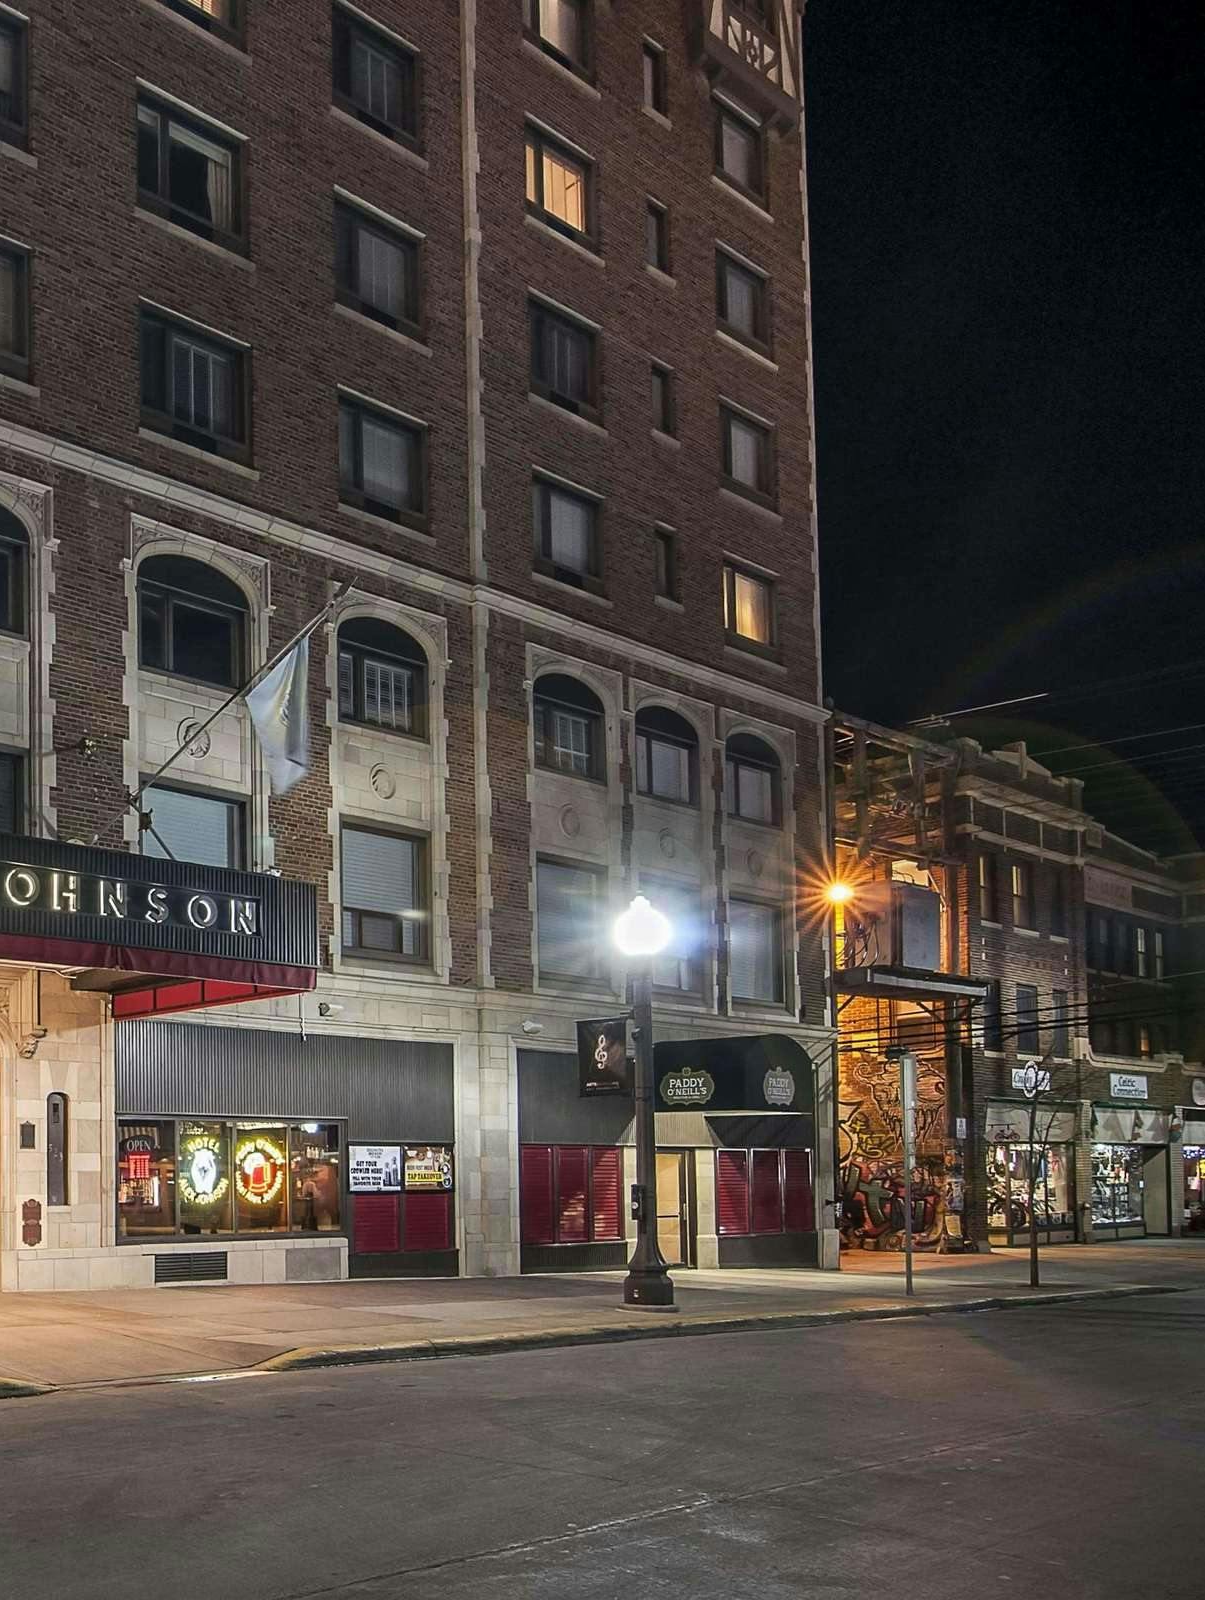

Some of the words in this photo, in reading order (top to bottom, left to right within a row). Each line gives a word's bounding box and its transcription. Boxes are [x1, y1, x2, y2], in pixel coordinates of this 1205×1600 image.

[669, 1078, 705, 1088] PADDY
[667, 1087, 707, 1096] O'NEILL'S
[126, 1139, 151, 1152] OPEN
[187, 1137, 220, 1153] HOTEL
